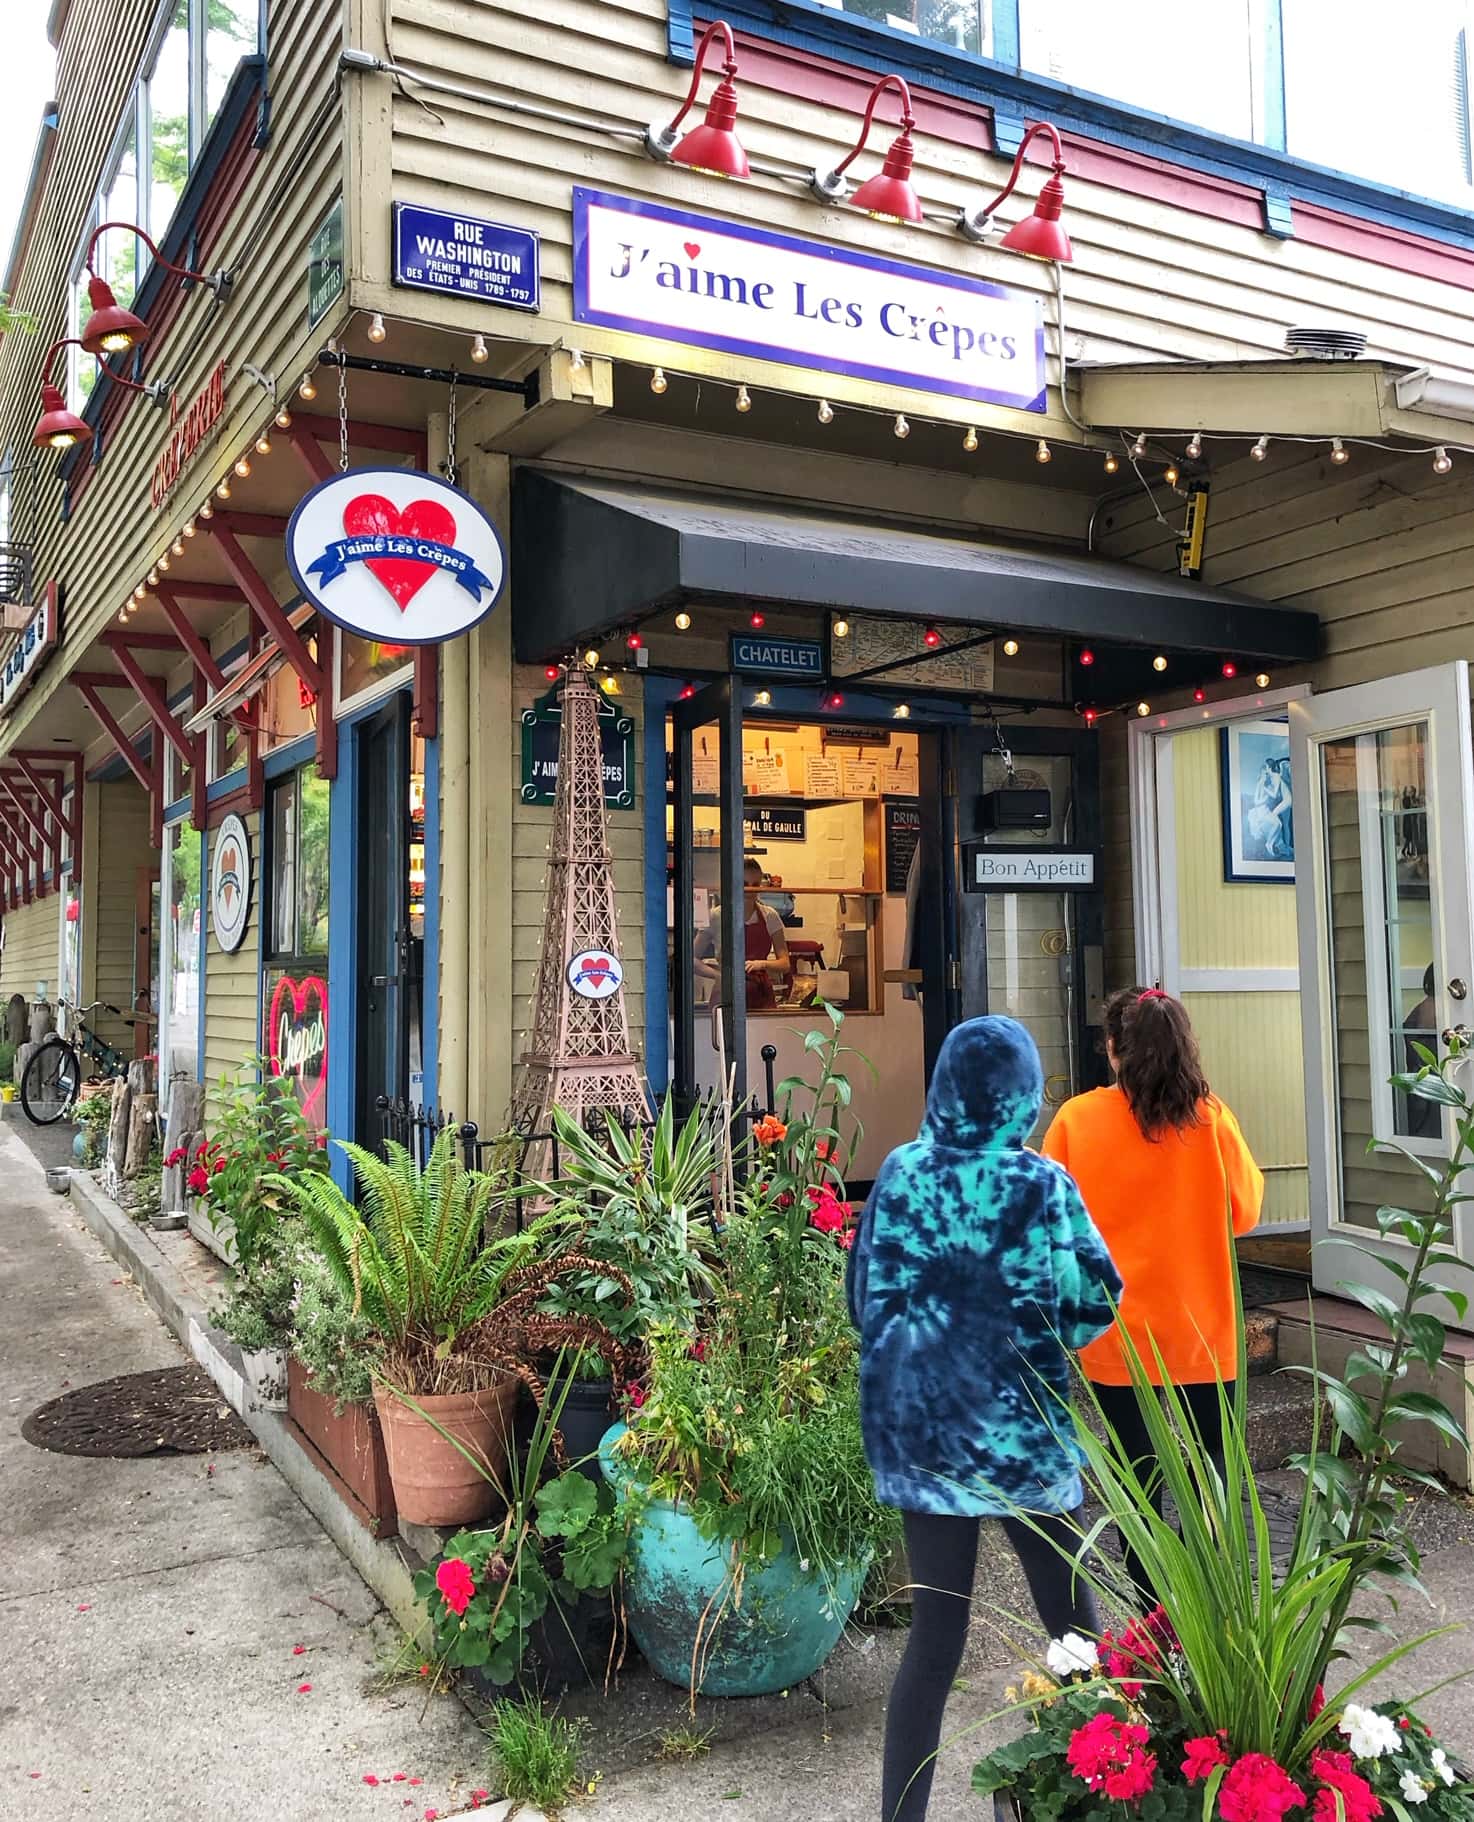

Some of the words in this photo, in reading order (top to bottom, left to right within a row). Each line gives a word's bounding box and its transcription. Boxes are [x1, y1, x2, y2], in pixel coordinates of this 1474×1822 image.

[453, 221, 485, 246] RUE
[415, 235, 521, 275] WASHINGTON
[406, 267, 423, 280] DES
[426, 259, 462, 276] PREMIER
[469, 267, 512, 285] PRÉSIDENT
[609, 242, 775, 310] J'aime
[792, 281, 864, 329] Les
[878, 302, 1018, 361] Crêpes
[334, 541, 384, 562] J'aime
[387, 540, 414, 554] Les
[417, 545, 467, 571] Crêpes
[739, 644, 817, 667] CHATELET
[760, 810, 771, 820] DU
[763, 821, 774, 832] DE
[774, 821, 802, 834] GAULLE
[982, 859, 1017, 876] Bon
[1023, 858, 1089, 880] Appétit
